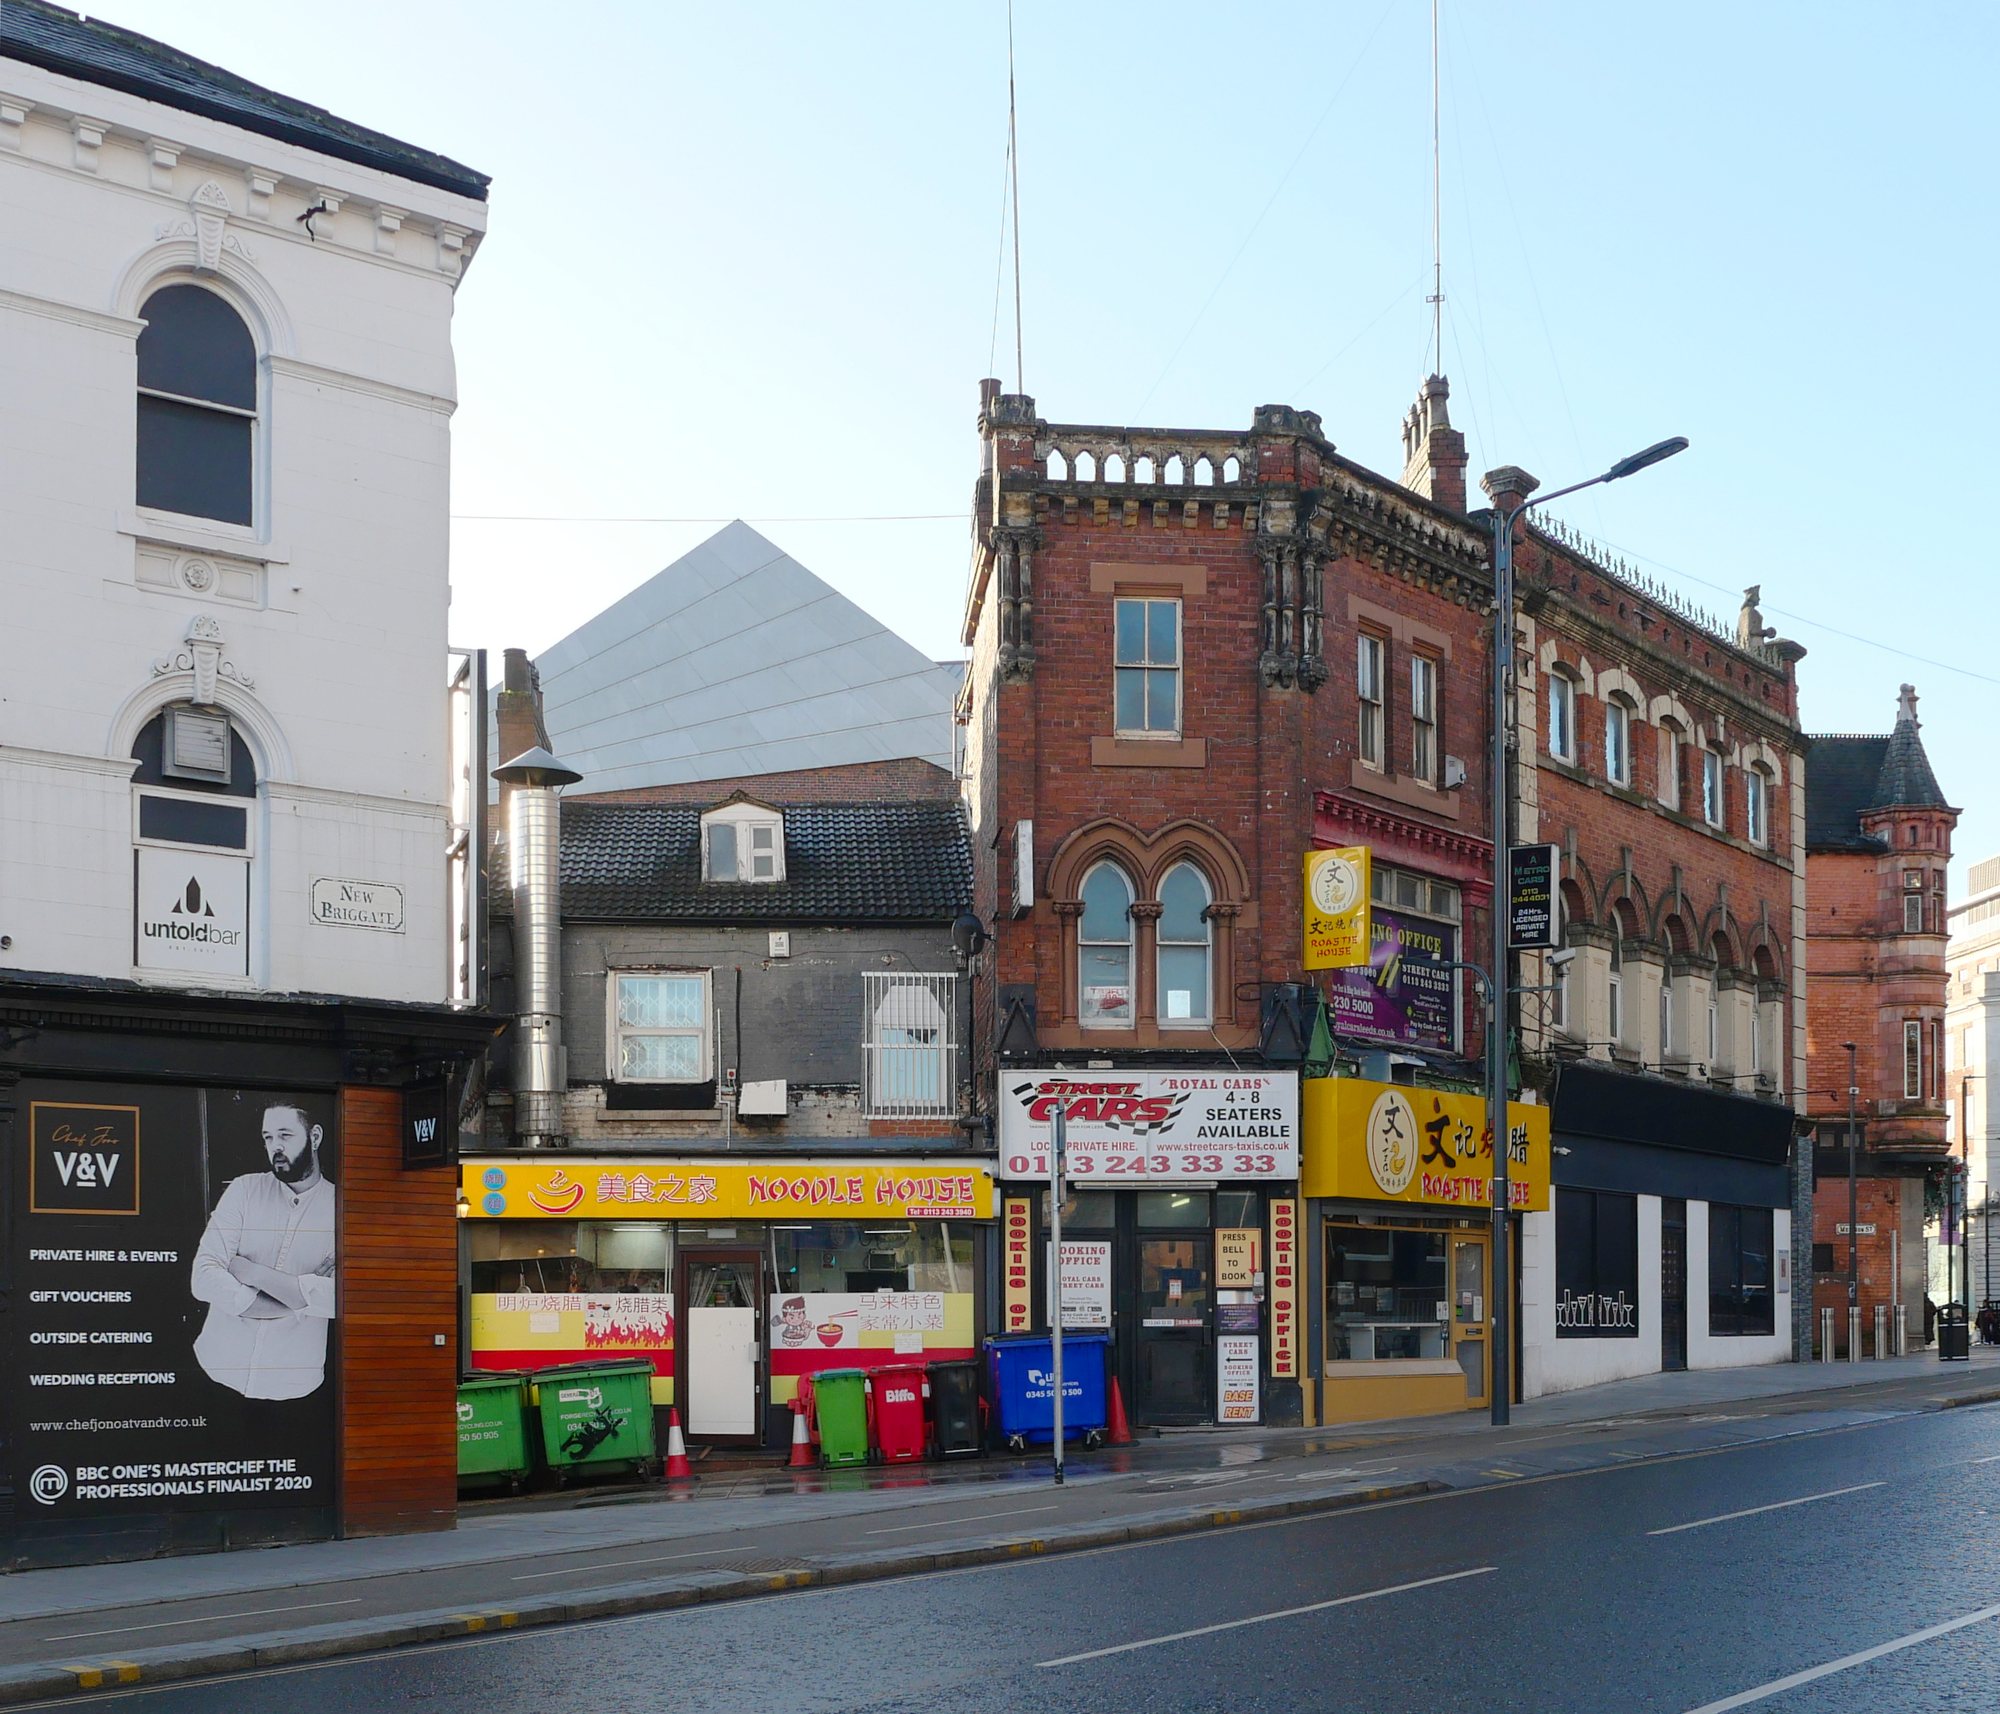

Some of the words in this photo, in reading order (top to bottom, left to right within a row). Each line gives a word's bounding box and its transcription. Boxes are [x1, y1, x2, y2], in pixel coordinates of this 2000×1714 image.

[340, 885, 374, 903] NEW
[321, 901, 395, 925] BRIGGATE
[1512, 914, 1548, 924] LICENSED
[144, 921, 241, 946] untoldbar
[1516, 922, 1545, 931] PRIVATE
[1311, 935, 1358, 948] ROASTIE
[1372, 923, 1393, 942] ING
[1397, 929, 1441, 953] OFFICE
[1316, 946, 1351, 957] HOUSE
[1402, 964, 1429, 978] STREET
[1432, 969, 1450, 981] CARS
[1403, 974, 1419, 986] 0113
[1420, 977, 1433, 989] 243
[1434, 980, 1450, 992] 3333
[1333, 995, 1350, 1010] 230
[1352, 999, 1374, 1014] 5000
[1037, 1082, 1142, 1095] STREET
[1168, 1079, 1218, 1090] ROYAL
[1223, 1079, 1262, 1090] CARS
[1225, 1091, 1235, 1104] 4
[1251, 1091, 1260, 1103] 8
[1029, 1097, 1174, 1121] CARS
[1206, 1108, 1282, 1121] SEATERS
[52, 1124, 87, 1146] Chef
[414, 1117, 436, 1143] V&V
[1197, 1125, 1290, 1138] AVAILABLE
[1031, 1141, 1050, 1151] LOC
[1067, 1141, 1109, 1151] PRIVATE
[1111, 1141, 1138, 1151] HIRE.
[1156, 1141, 1289, 1152] www.streetcars-taxis.co.uk
[53, 1151, 120, 1188] V&V
[1009, 1155, 1095, 1174] 013
[1105, 1155, 1171, 1174] 243
[1181, 1154, 1223, 1173] 33
[1233, 1154, 1276, 1173] 33
[597, 1173, 718, 1205] 美食之家
[747, 1174, 864, 1205] NOODLE
[875, 1174, 974, 1205] HOUSE
[1421, 1171, 1482, 1202] ROASTIE
[923, 1208, 940, 1216] 0113
[940, 1208, 954, 1216] 243
[955, 1208, 972, 1216] 3940
[1222, 1233, 1247, 1241] PRESS
[1009, 1204, 1027, 1288] BOOKING
[1060, 1246, 1106, 1255] OOKING
[1222, 1246, 1244, 1254] BELL
[1275, 1205, 1293, 1288] BOOKING
[30, 1249, 83, 1261] PRIVATE
[85, 1250, 115, 1261] HIRE
[117, 1251, 128, 1262] &
[130, 1251, 177, 1262] EVENTS
[1221, 1272, 1246, 1280] BOOK
[30, 1291, 59, 1302] GIFT
[61, 1291, 132, 1303] VOUCHERS
[615, 1296, 668, 1313] 烧腊类
[860, 1294, 941, 1310] 马来特色
[860, 1314, 942, 1331] 家常小菜
[30, 1333, 88, 1344] OUTSIDE
[89, 1332, 153, 1344] CATERING
[1275, 1301, 1292, 1373] OFFICE
[30, 1374, 95, 1386] WEDDING
[98, 1372, 176, 1385] RECEPTIONS
[885, 1388, 916, 1403] Biffa
[1026, 1390, 1045, 1398] 0345
[1068, 1388, 1082, 1396] 500
[1224, 1390, 1254, 1402] BASE
[1224, 1406, 1254, 1418] RENT
[30, 1416, 207, 1432] www.chefjonoatvandv.co.uk
[76, 1466, 109, 1480] BBC
[164, 1460, 265, 1477] MASTERCHEF
[267, 1459, 297, 1473] THE
[76, 1480, 205, 1500] PROFESSIONALS
[207, 1478, 273, 1493] FINALIST
[274, 1475, 313, 1491] 2020
